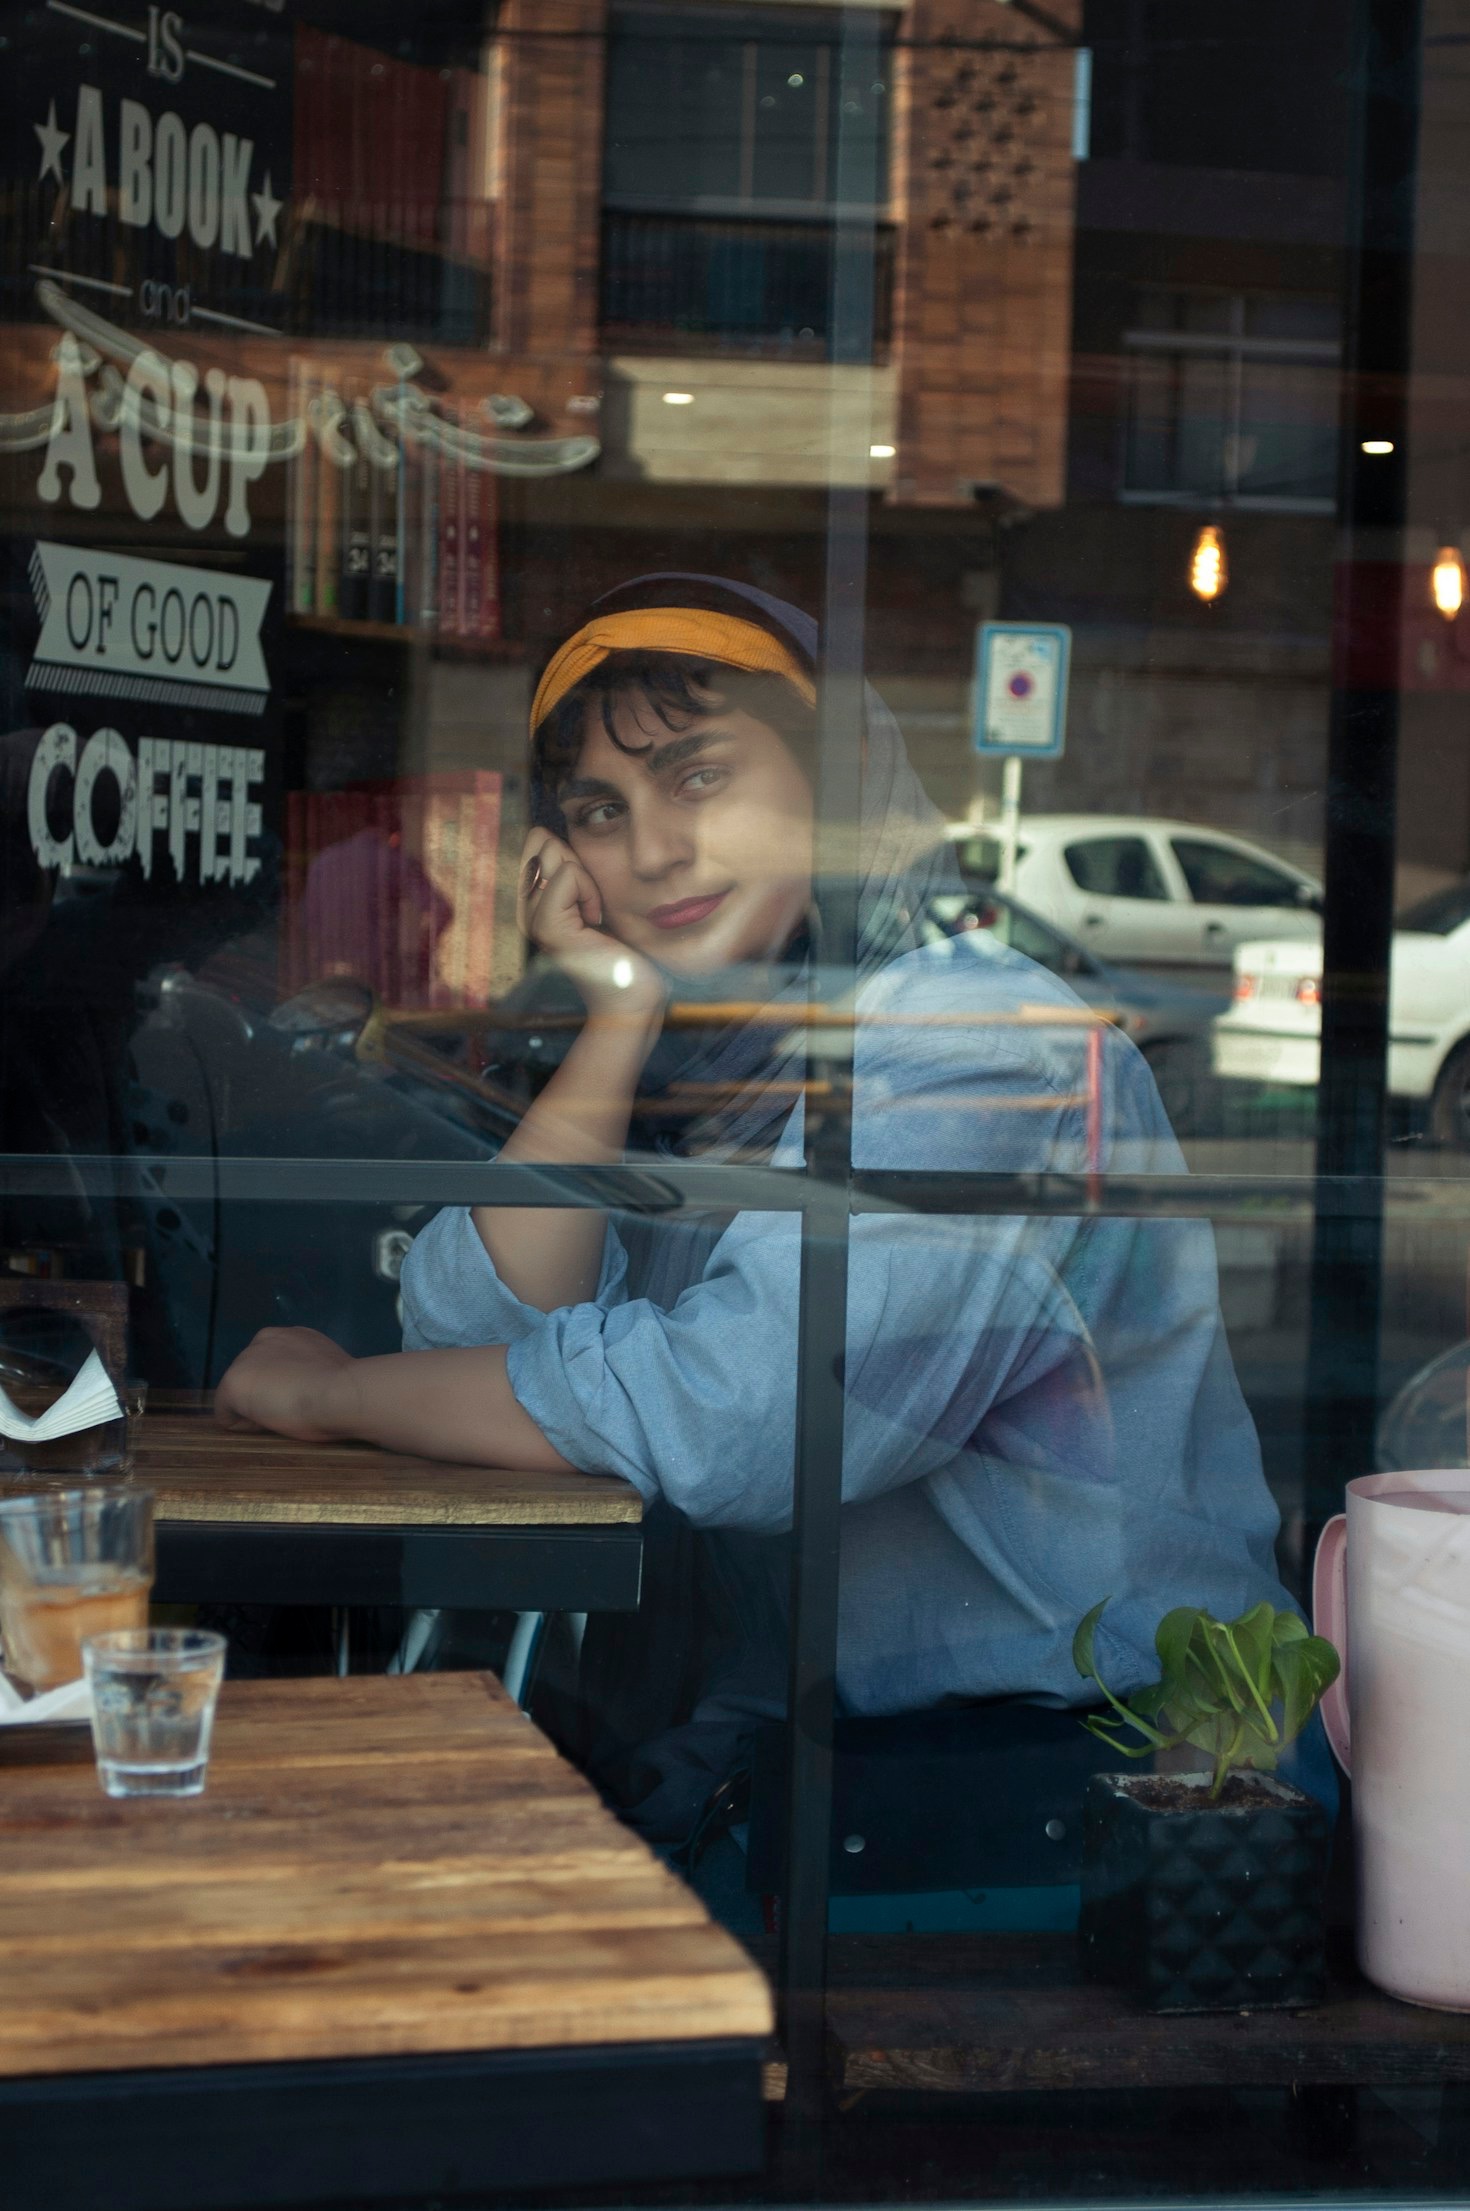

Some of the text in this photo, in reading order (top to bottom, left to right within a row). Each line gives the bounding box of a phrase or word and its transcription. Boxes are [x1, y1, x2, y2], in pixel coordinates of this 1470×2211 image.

[147, 5, 185, 83] IS
[71, 82, 255, 260] A BOOK
[139, 279, 191, 325] and
[37, 330, 102, 510] A
[120, 350, 271, 538] CUP
[66, 571, 240, 671] OF GOOD
[27, 721, 266, 888] COFFEE
